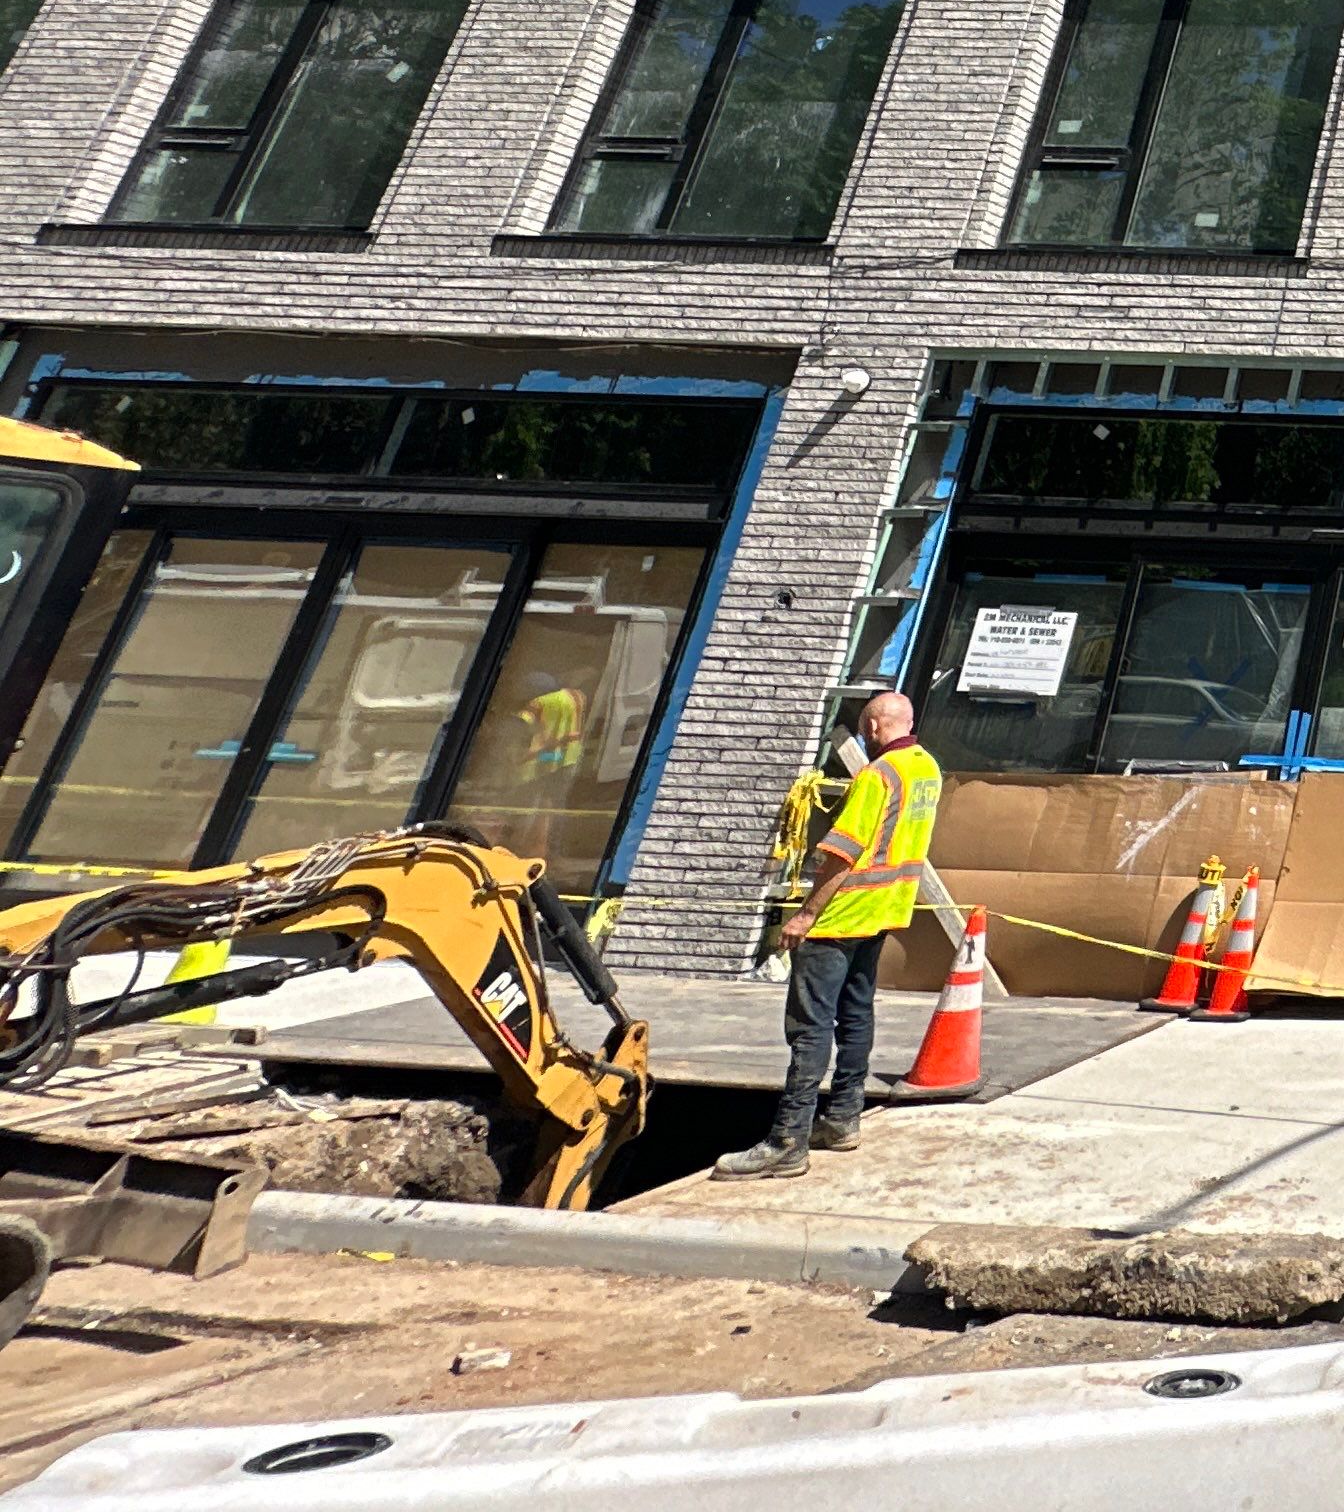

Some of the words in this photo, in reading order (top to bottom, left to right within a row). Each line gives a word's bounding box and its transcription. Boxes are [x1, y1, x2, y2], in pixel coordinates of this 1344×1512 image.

[990, 625, 1019, 636] WATER
[1028, 627, 1058, 637] SEWER
[480, 971, 528, 1024] CAT
